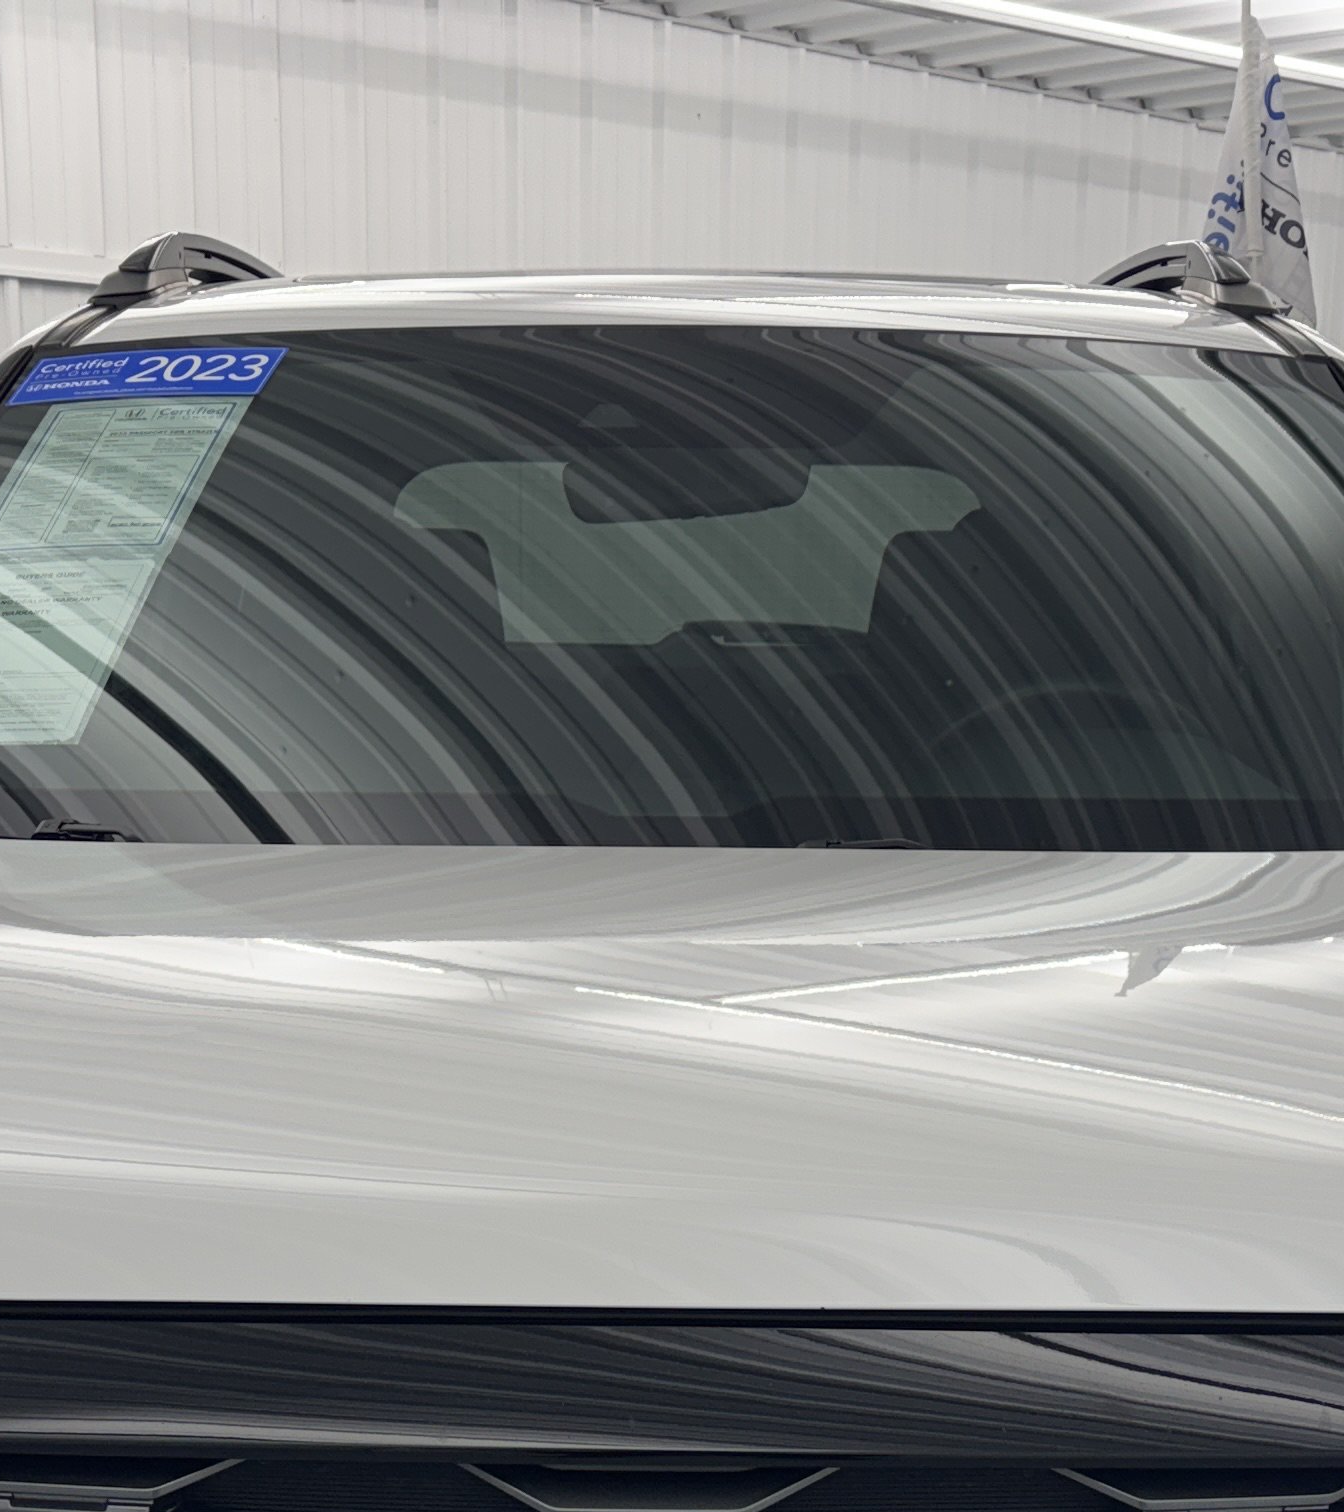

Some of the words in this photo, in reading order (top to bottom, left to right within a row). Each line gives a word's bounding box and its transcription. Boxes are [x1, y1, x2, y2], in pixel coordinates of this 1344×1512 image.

[40, 356, 130, 374] Certified
[124, 354, 270, 383] 2023
[43, 379, 110, 390] HONDA
[159, 406, 227, 418] Certified
